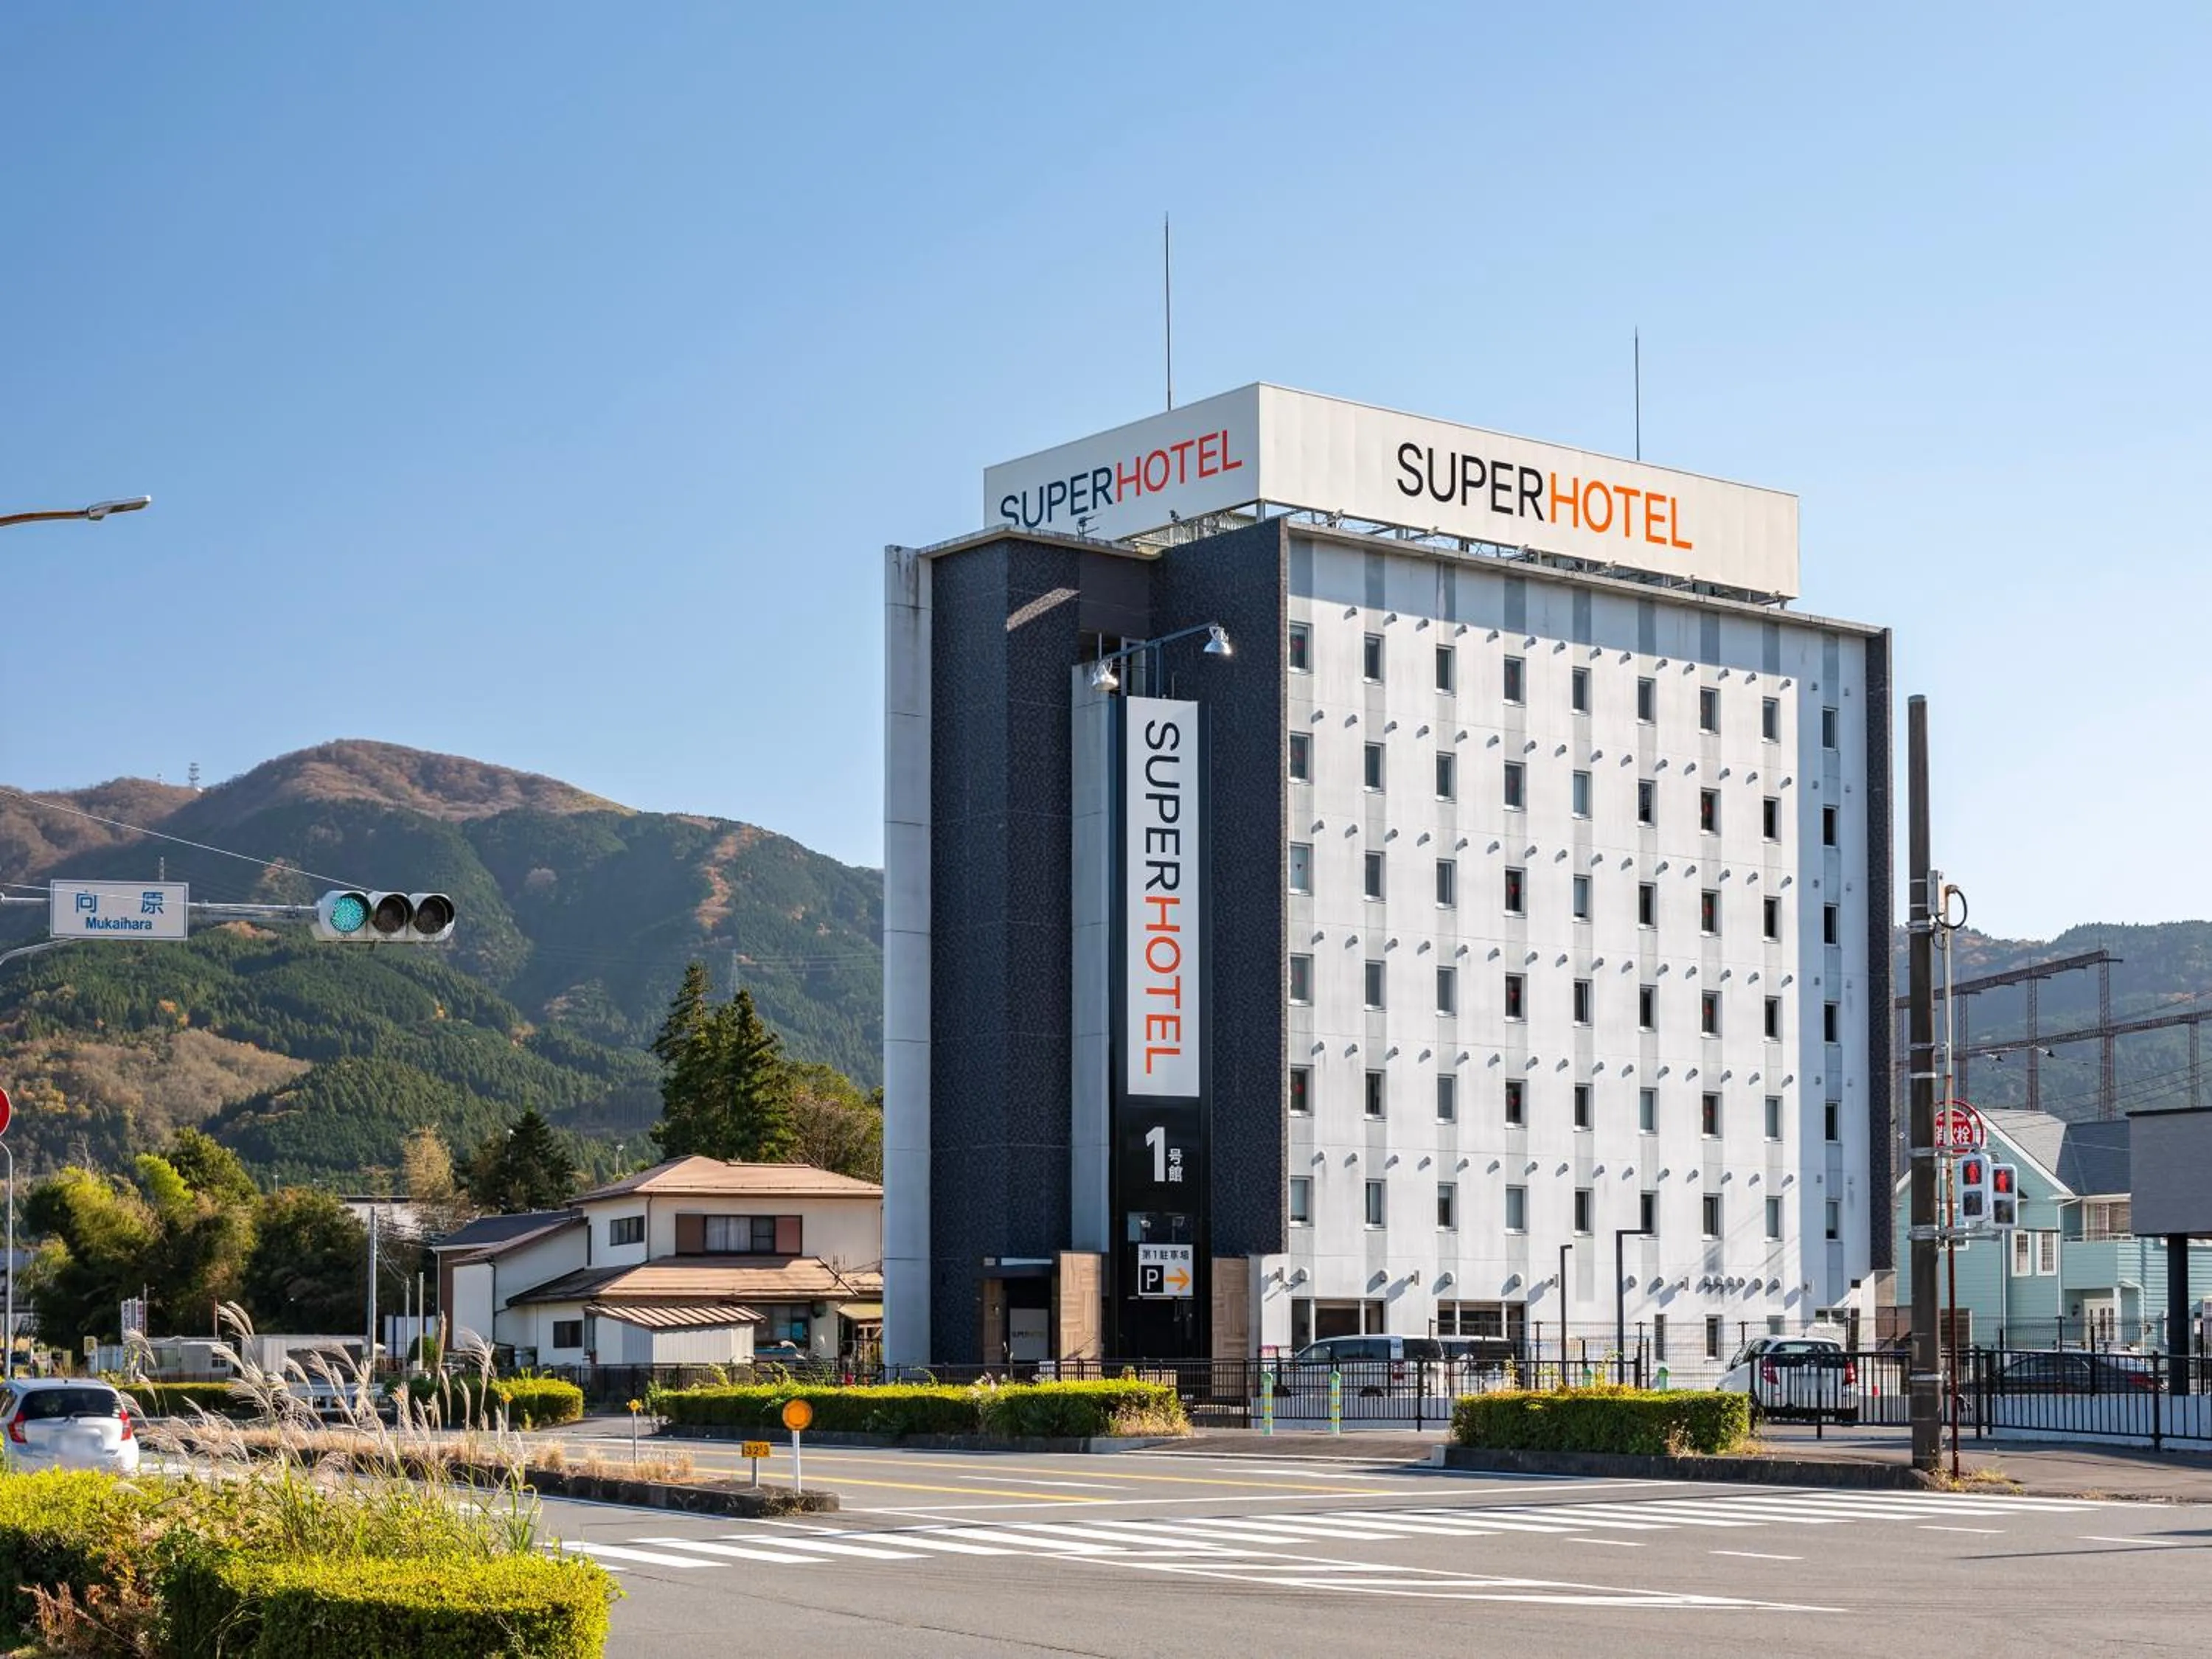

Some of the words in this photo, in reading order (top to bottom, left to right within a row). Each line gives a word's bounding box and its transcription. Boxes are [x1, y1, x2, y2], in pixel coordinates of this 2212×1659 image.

[1000, 429, 1243, 528] SUPERHOTEL
[1397, 442, 1694, 550] SUPERHOTEL
[85, 917, 153, 930] Mukaihara
[1144, 720, 1181, 1074] SUPERHOTEL
[1143, 1249, 1189, 1260] 第1駐車場
[1147, 1269, 1158, 1290] P
